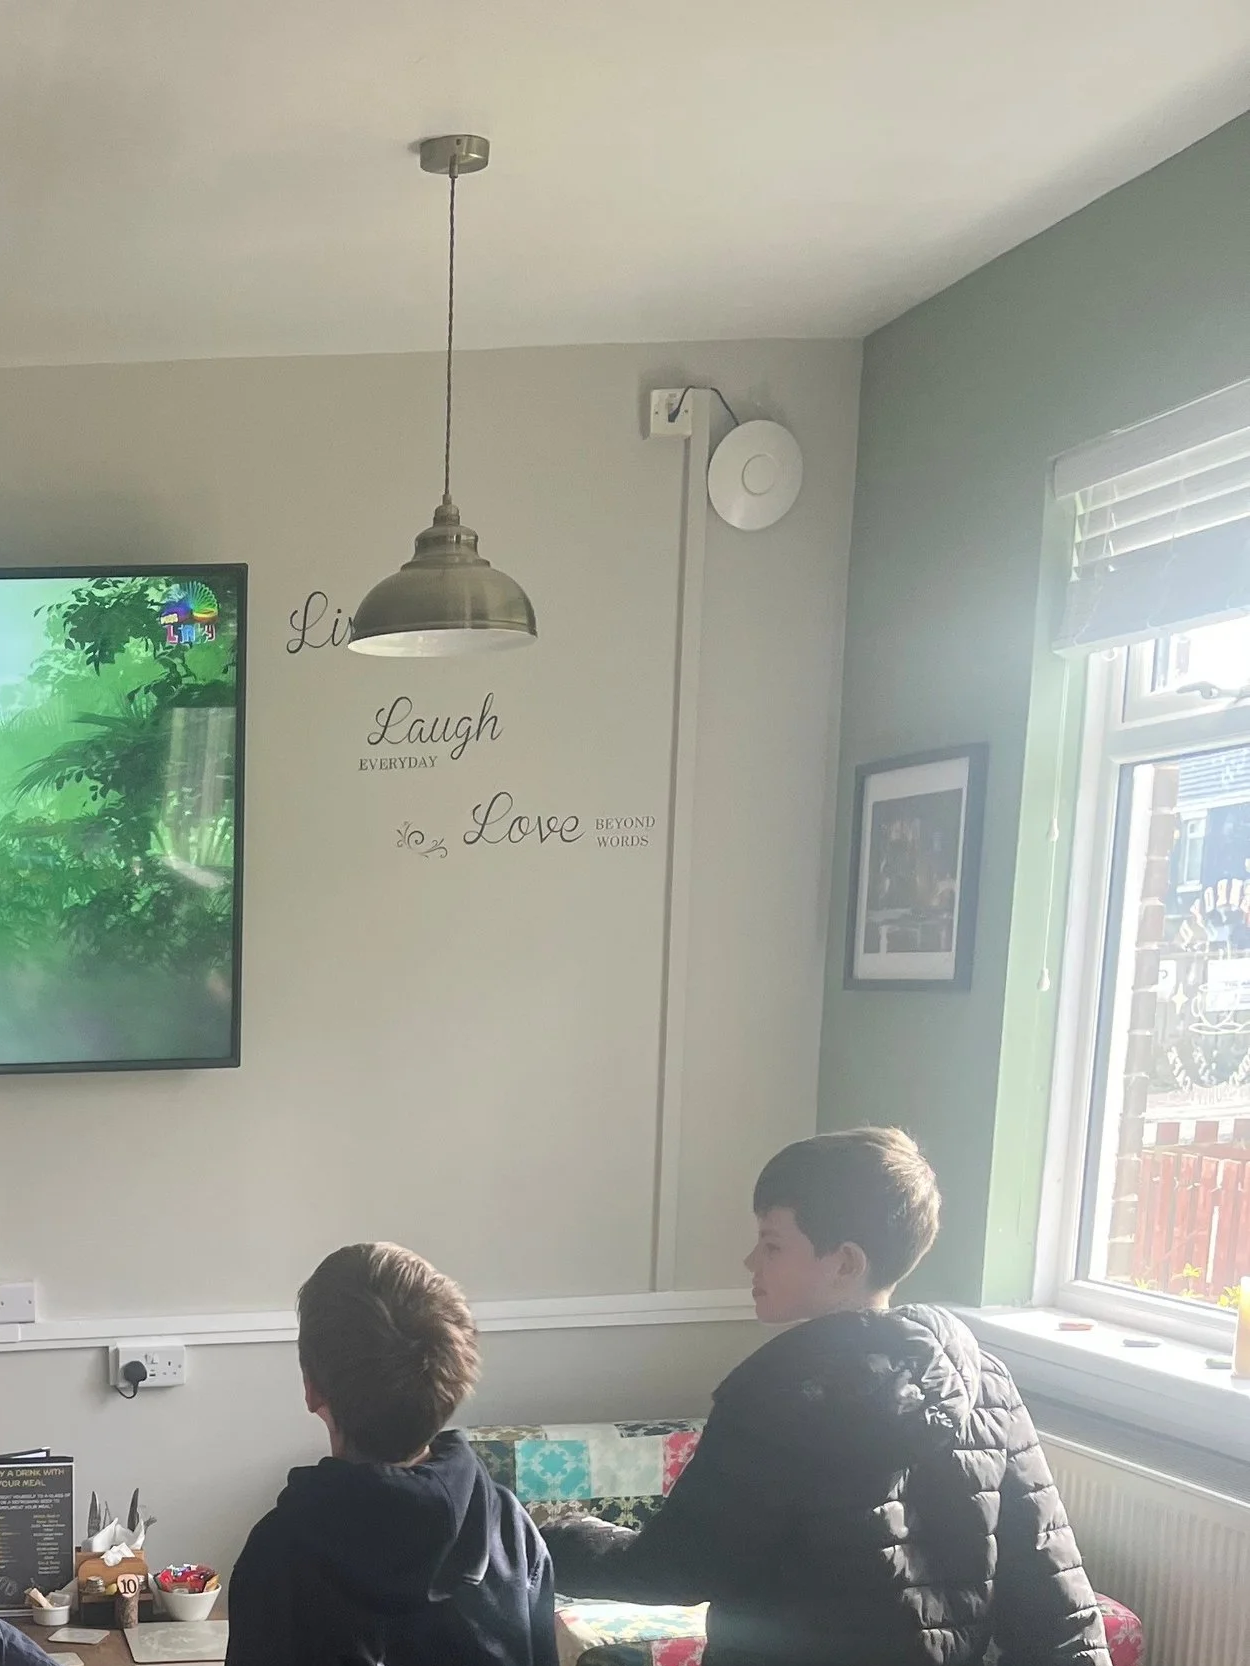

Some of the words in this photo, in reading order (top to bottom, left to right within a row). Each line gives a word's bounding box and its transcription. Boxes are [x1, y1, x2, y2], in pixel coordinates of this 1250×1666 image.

[286, 591, 355, 654] Li
[367, 692, 503, 760] Laugh
[358, 755, 438, 771] EVERYDAY
[463, 791, 584, 845] Love
[595, 816, 656, 831] BEYOND
[597, 835, 649, 848] WORDS
[22, 1479, 46, 1487] MEAL
[120, 1579, 137, 1594] 10
